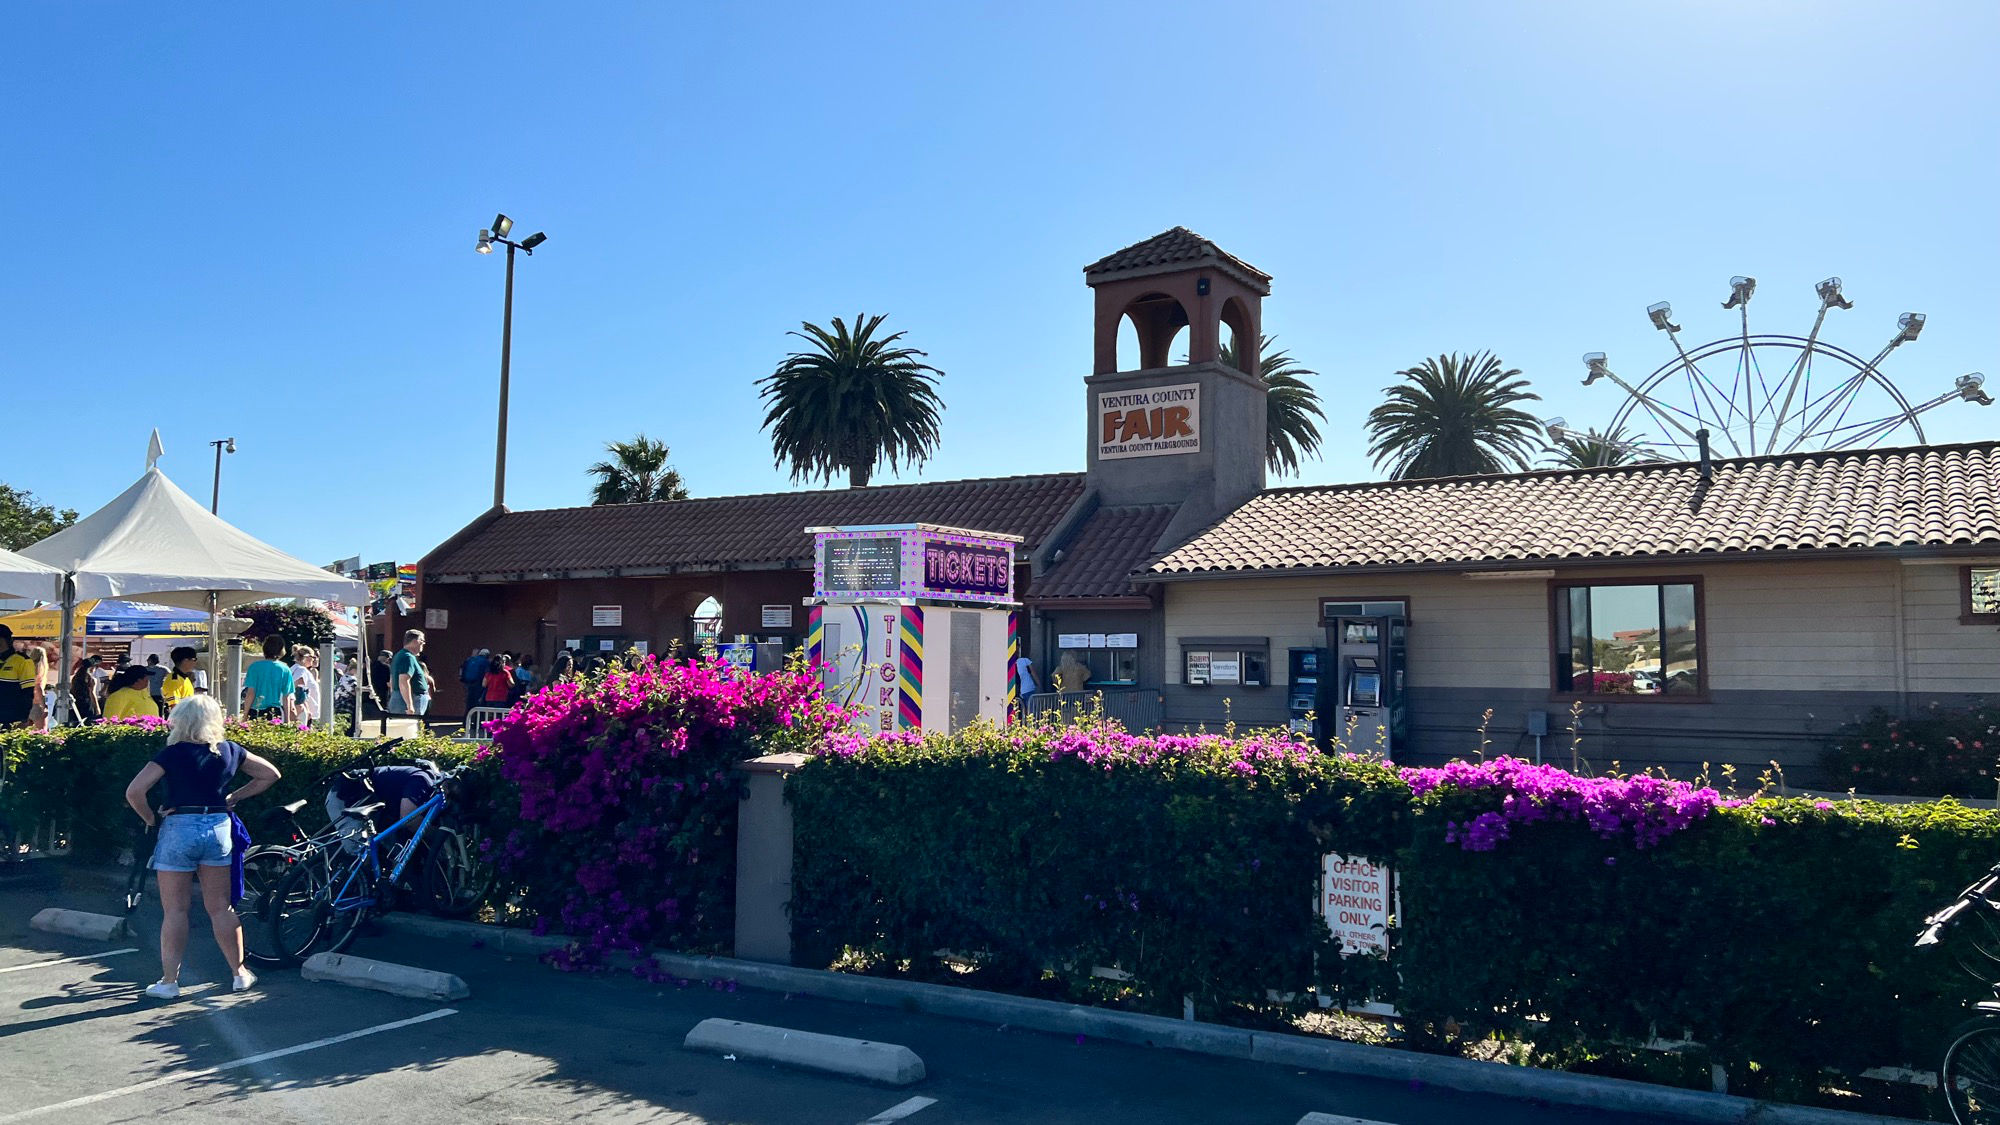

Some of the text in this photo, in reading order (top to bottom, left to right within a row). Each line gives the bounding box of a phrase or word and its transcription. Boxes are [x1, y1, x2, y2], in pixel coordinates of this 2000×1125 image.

[1102, 388, 1196, 408] VENTURA COUNTY
[1103, 405, 1195, 444] FAIR
[1100, 438, 1198, 455] VENTURA COUNTY FAIRGROUNDS
[927, 548, 1008, 588] TICKETS
[1334, 861, 1378, 878] OFFICE
[1332, 877, 1379, 894] VISITOR
[1328, 893, 1382, 912] PARKING
[1339, 911, 1371, 926] ONLY
[1334, 929, 1376, 941] ALL OTHERS
